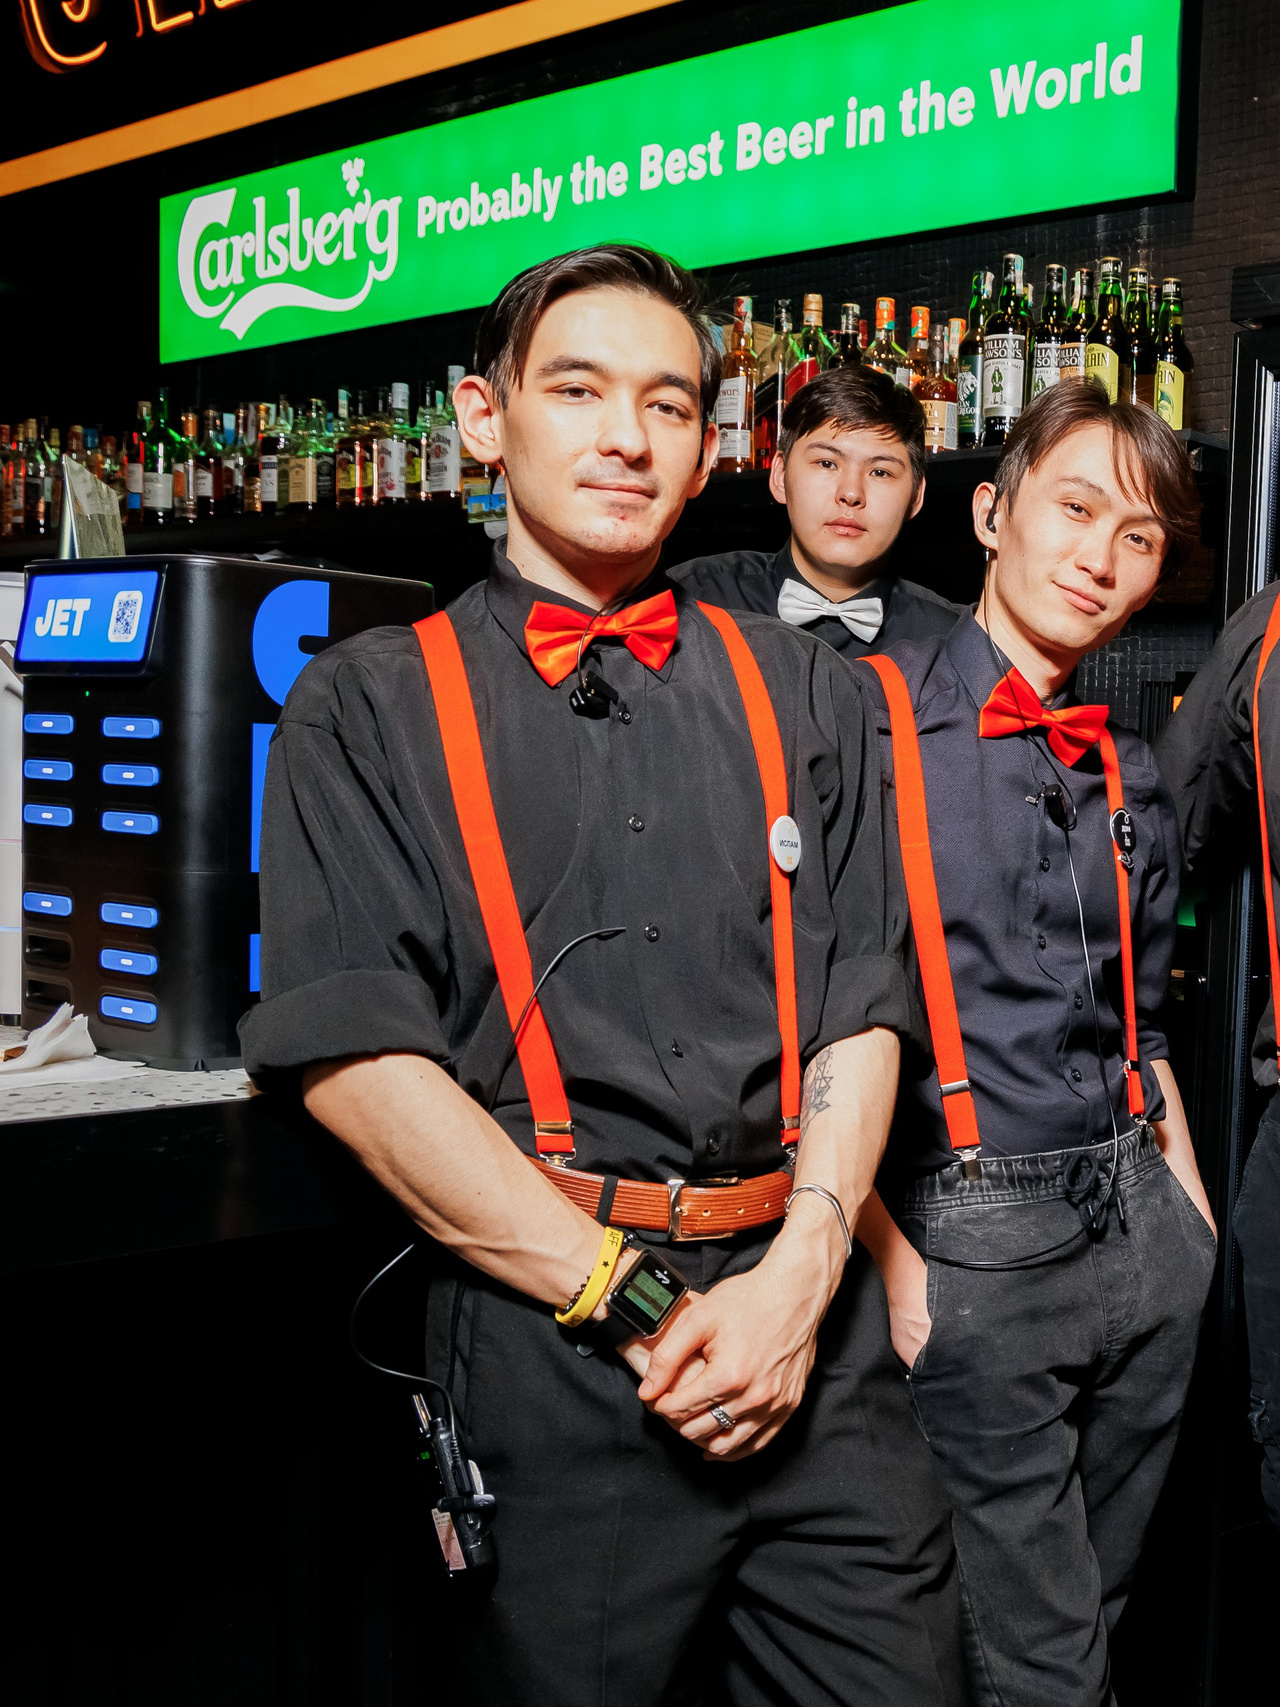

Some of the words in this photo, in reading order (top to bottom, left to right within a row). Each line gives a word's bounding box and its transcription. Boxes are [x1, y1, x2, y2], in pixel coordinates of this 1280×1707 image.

[417, 166, 563, 238] Probably
[569, 154, 629, 205] the
[639, 131, 725, 191] Best
[736, 115, 835, 172] Beer
[845, 96, 886, 149] in
[898, 80, 977, 138] the
[989, 35, 1143, 119] World
[178, 186, 402, 339] Carlsberg
[33, 598, 91, 637] JET
